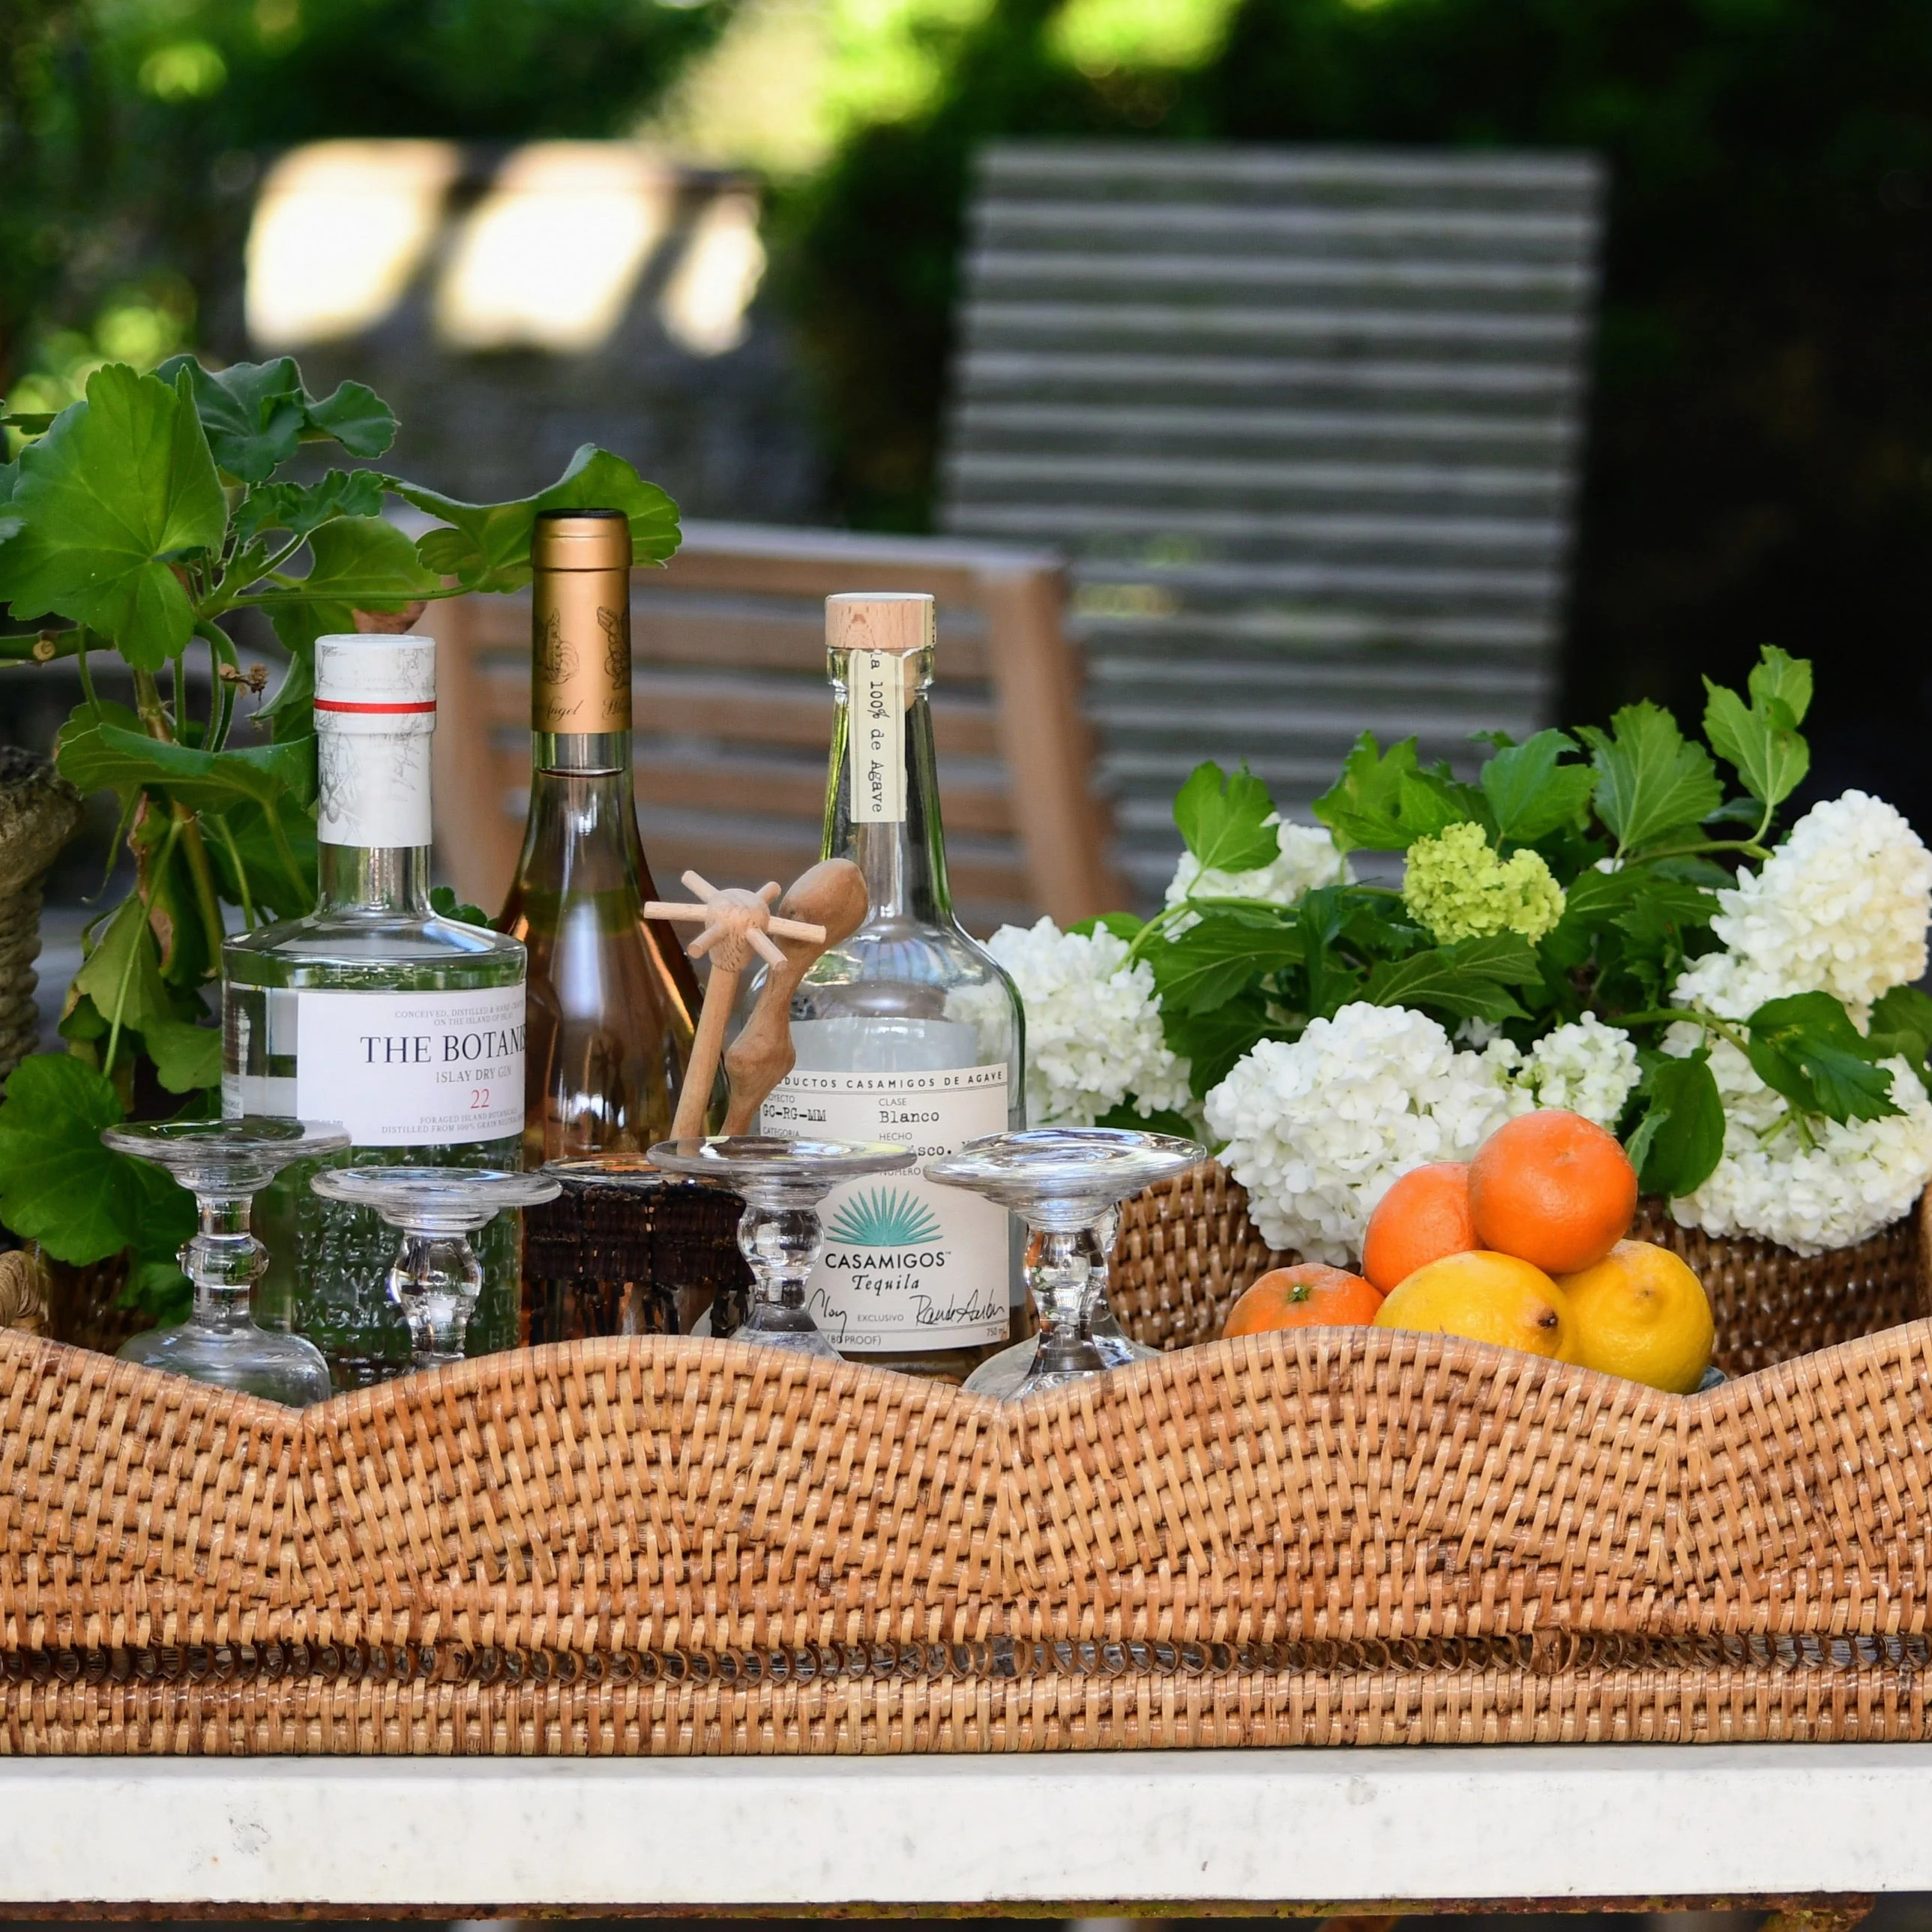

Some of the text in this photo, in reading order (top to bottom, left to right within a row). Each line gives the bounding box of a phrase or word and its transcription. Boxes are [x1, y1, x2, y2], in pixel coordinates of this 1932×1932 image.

[870, 681, 891, 719] 100%
[870, 728, 885, 750] de
[867, 760, 885, 813] Agave
[395, 1009, 449, 1019] CONCEIVED,
[451, 1006, 490, 1017] DISTILLED
[449, 1017, 464, 1026] THE
[466, 1015, 490, 1024] ISLAND
[360, 1036, 432, 1063] THE
[436, 1065, 512, 1083] ISLAY DRY GIN
[780, 1070, 1003, 1089] DUCTOS CASAMIGOS DE AGAVE
[470, 1088, 490, 1109] 22
[879, 1098, 907, 1107] CLASE
[420, 1115, 460, 1125] FORAGED
[460, 1113, 487, 1122] ISLAND
[762, 1104, 827, 1122] GC-RG-MM
[879, 1110, 940, 1125] Blanco
[382, 1125, 430, 1134] DISTILLED
[431, 1125, 454, 1134] FROM
[457, 1123, 476, 1132] 100%
[879, 1132, 913, 1141] HECHO
[852, 1274, 920, 1296] Tequila
[857, 1313, 904, 1322] EXCLUSIVO
[986, 1327, 998, 1337] 750
[844, 1334, 882, 1346] PROOF)
